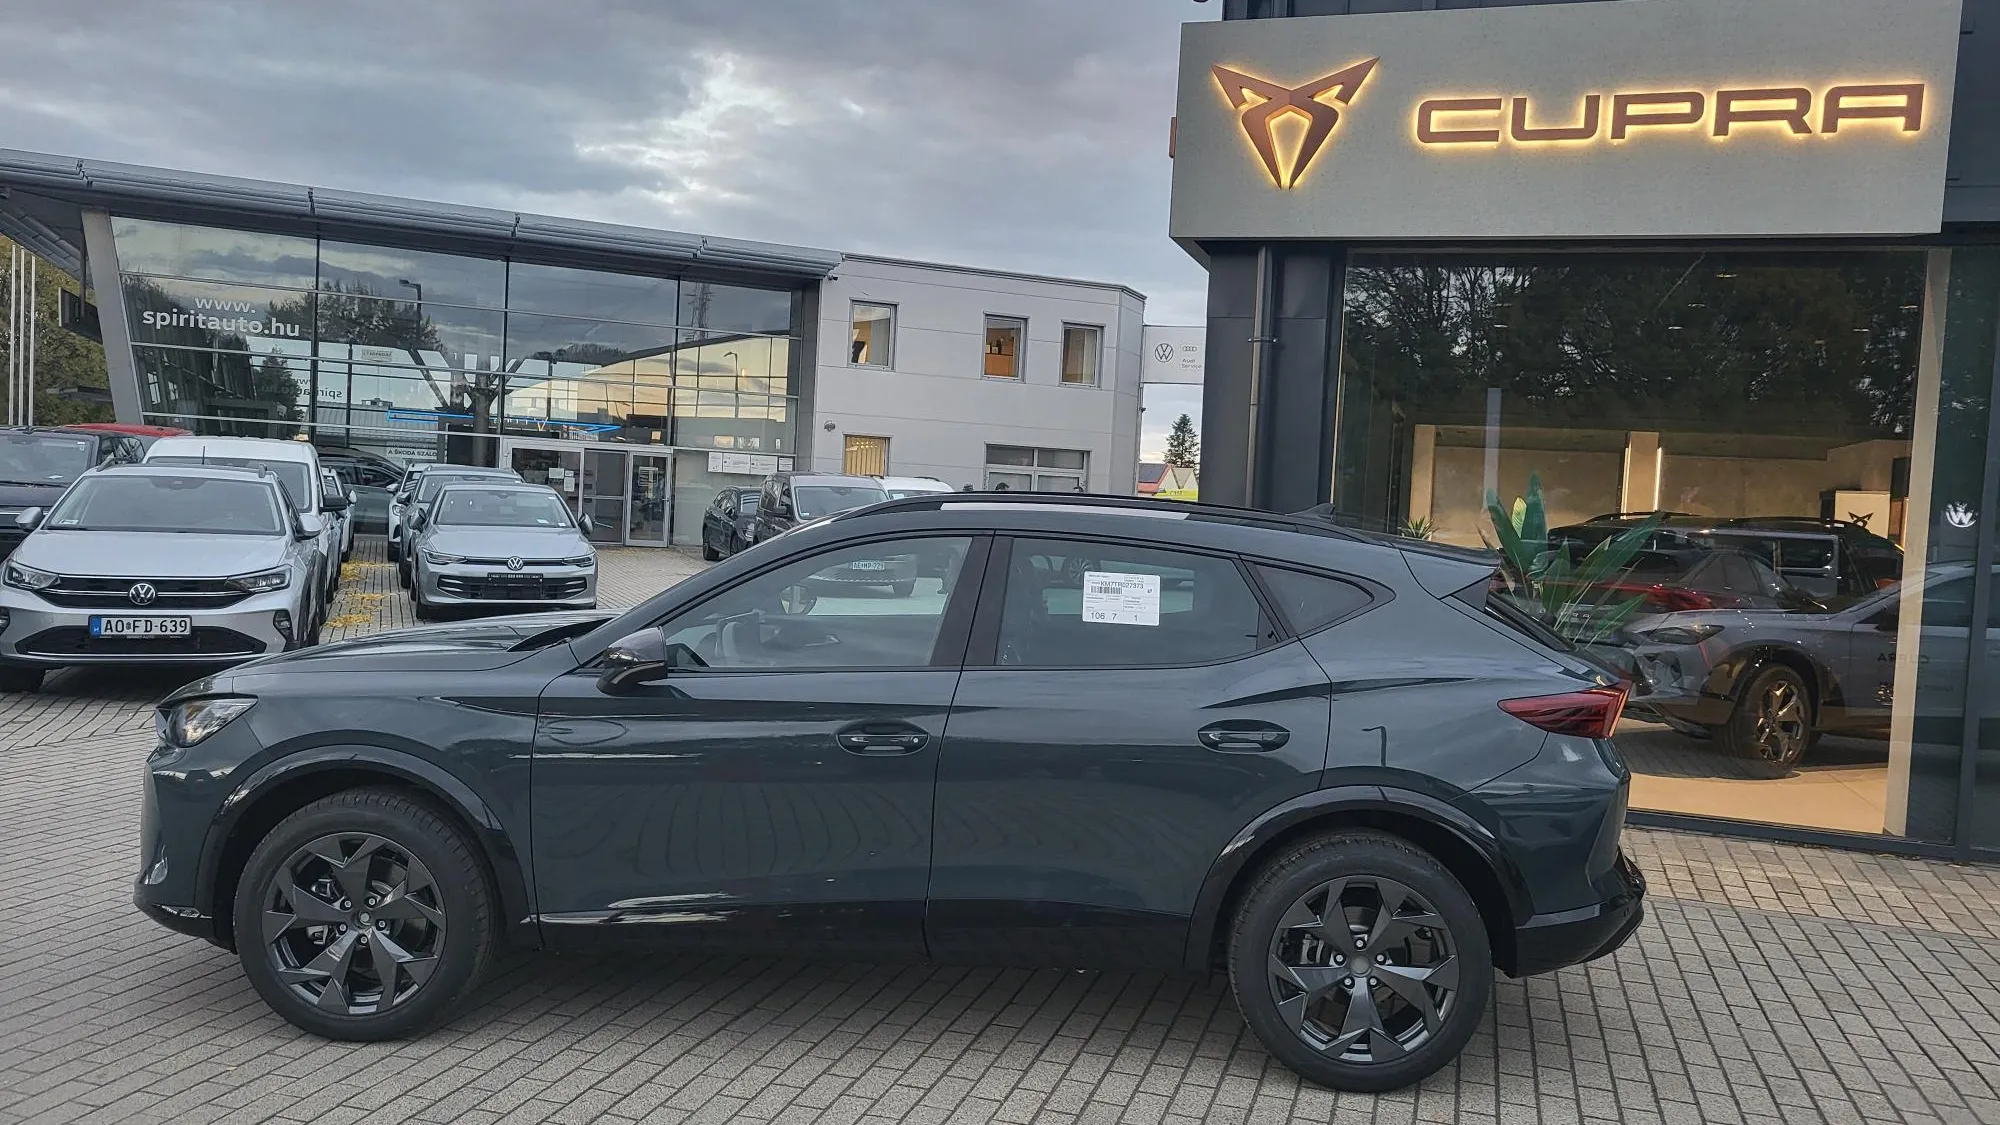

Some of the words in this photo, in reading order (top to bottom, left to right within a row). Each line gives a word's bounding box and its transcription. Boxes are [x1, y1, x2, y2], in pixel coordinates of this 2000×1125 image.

[1416, 83, 1925, 144] CUPRA
[194, 297, 256, 314] www.
[142, 308, 300, 337] spiritauto.hu
[132, 619, 188, 633] FD-639
